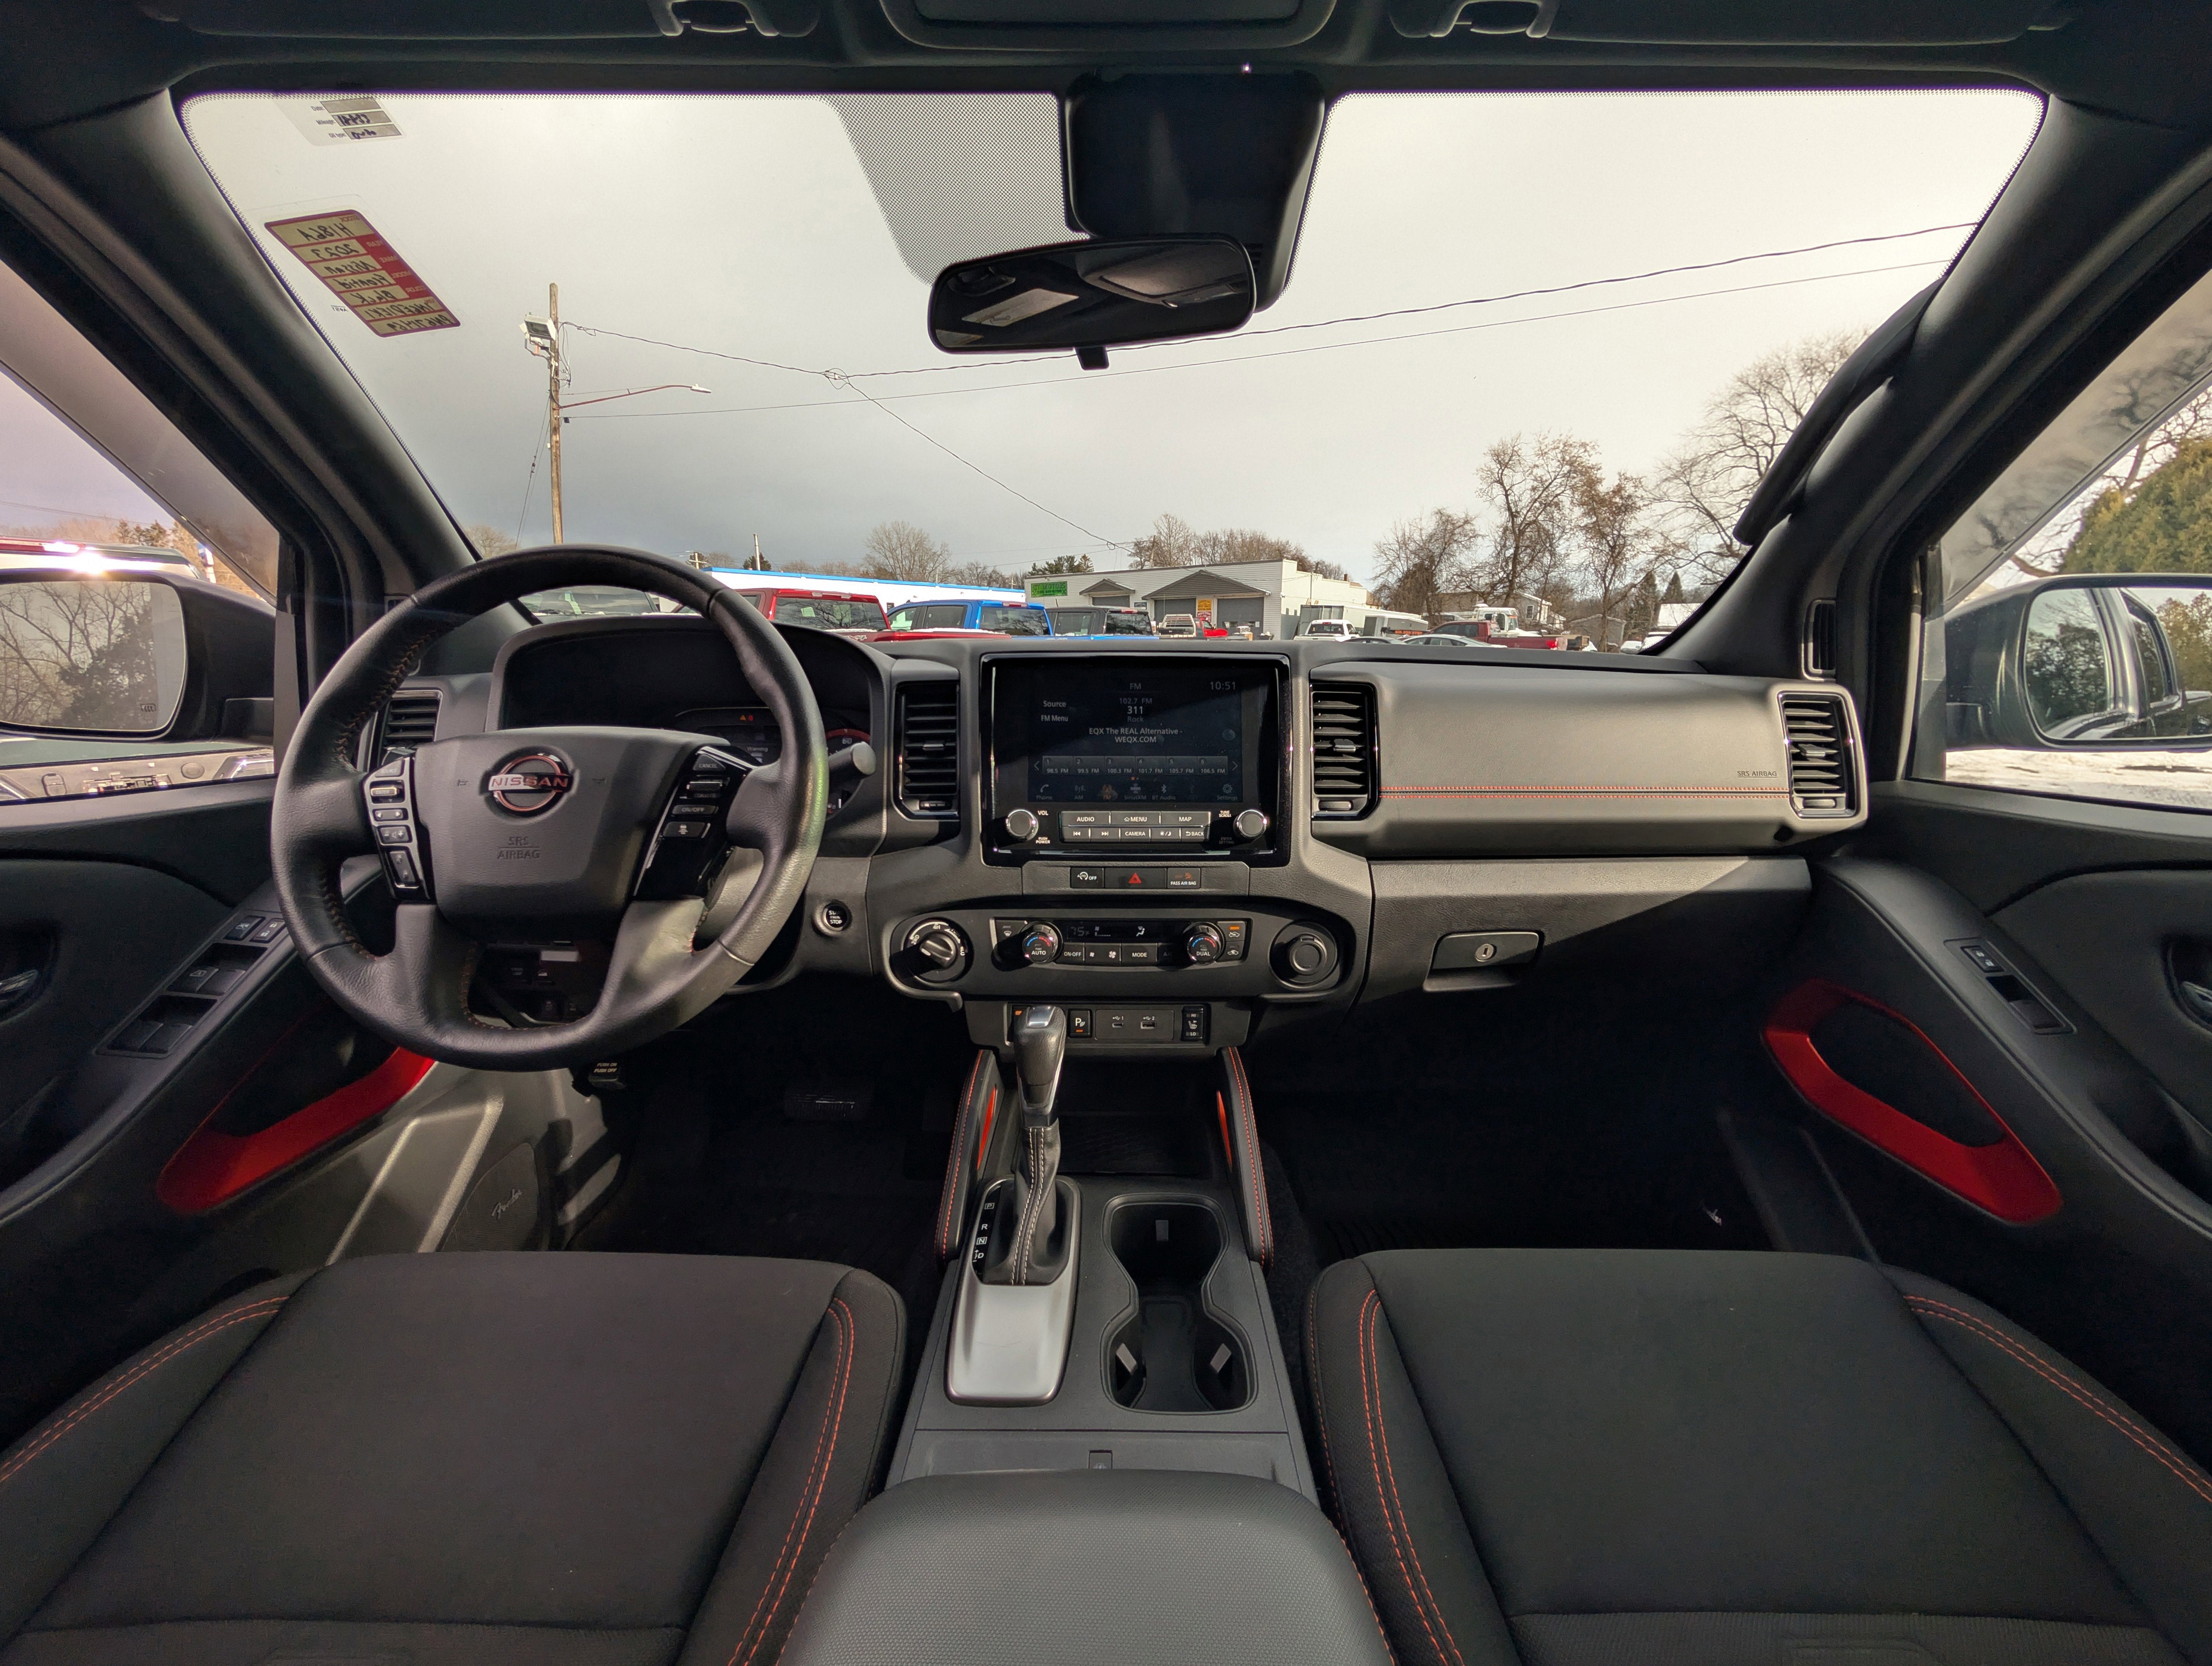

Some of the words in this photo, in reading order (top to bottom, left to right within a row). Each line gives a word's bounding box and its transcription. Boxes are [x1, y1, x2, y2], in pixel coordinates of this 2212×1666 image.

[1210, 681, 1236, 690] 10:51
[1127, 706, 1143, 714] 311
[492, 777, 568, 787] NISSAN
[509, 836, 528, 846] SRS
[497, 850, 540, 860] AIRBAG
[1075, 1017, 1082, 1026] P
